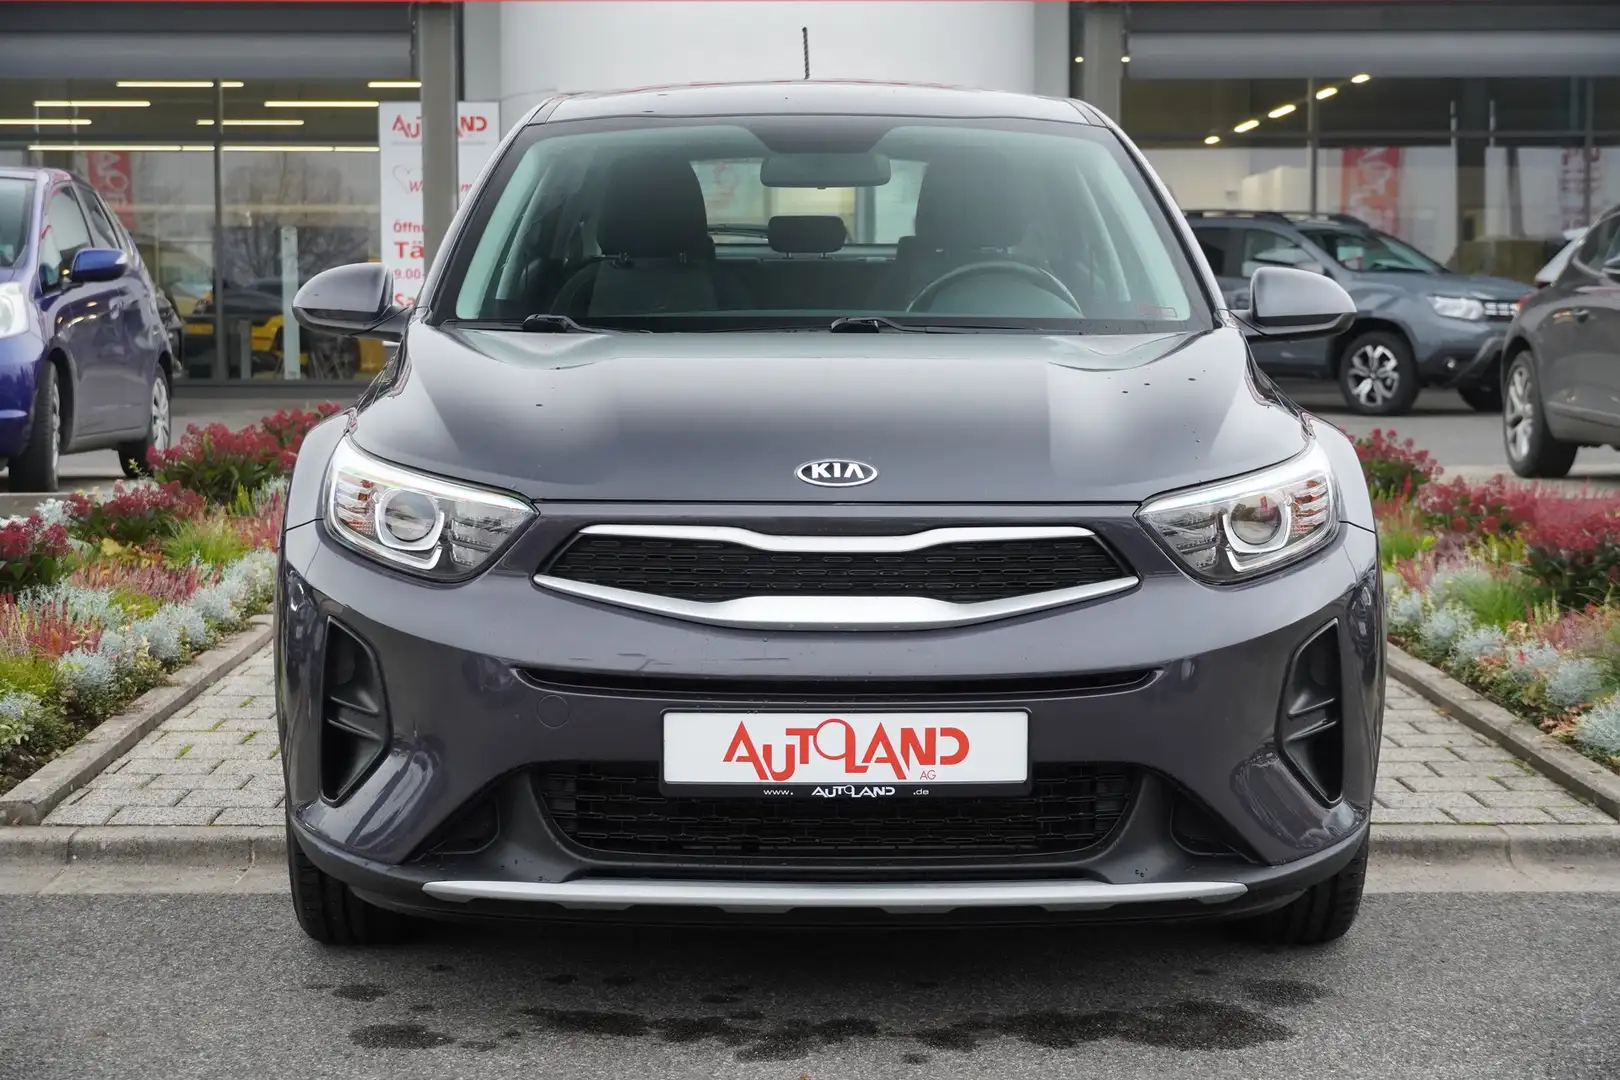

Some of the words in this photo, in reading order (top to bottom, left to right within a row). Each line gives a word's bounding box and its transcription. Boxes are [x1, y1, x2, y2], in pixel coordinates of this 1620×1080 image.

[811, 462, 865, 479] KIA
[722, 718, 970, 782] AUTOLAND
[919, 769, 937, 781] AG
[763, 788, 794, 796] www.
[811, 784, 896, 798] AUTOLAND
[912, 788, 930, 796] .de
